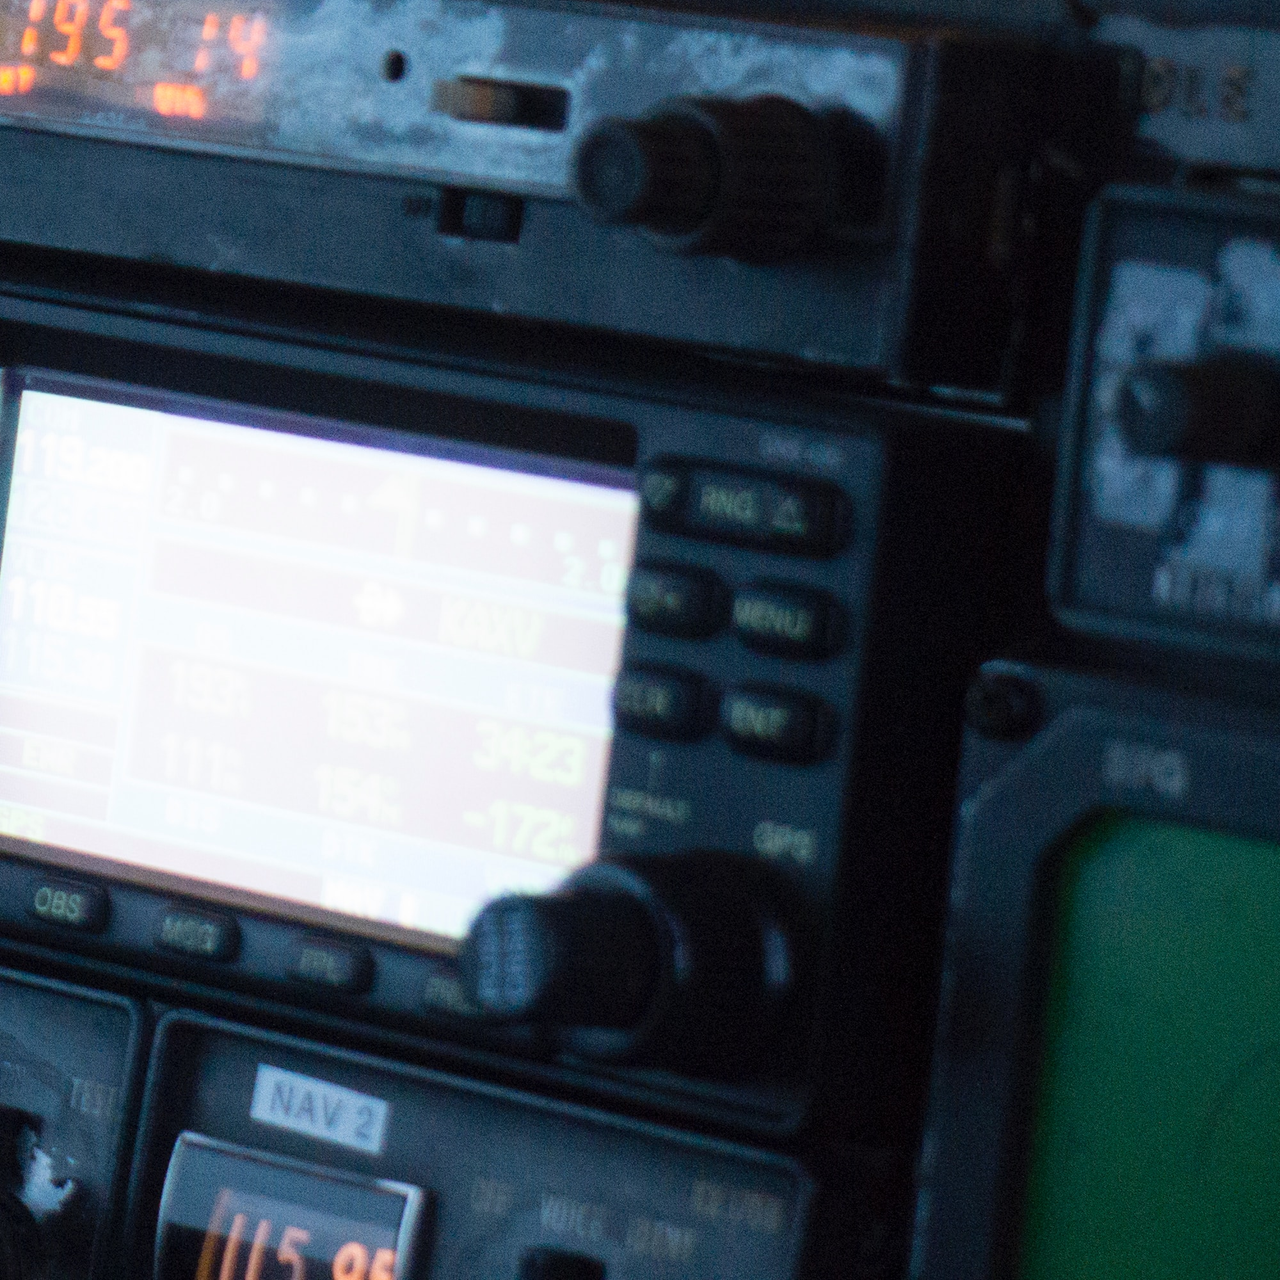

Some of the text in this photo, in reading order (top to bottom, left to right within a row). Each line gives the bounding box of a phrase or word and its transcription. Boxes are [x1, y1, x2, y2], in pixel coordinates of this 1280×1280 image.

[33, 886, 82, 923] OBS
[269, 1078, 375, 1141] NAV 2
